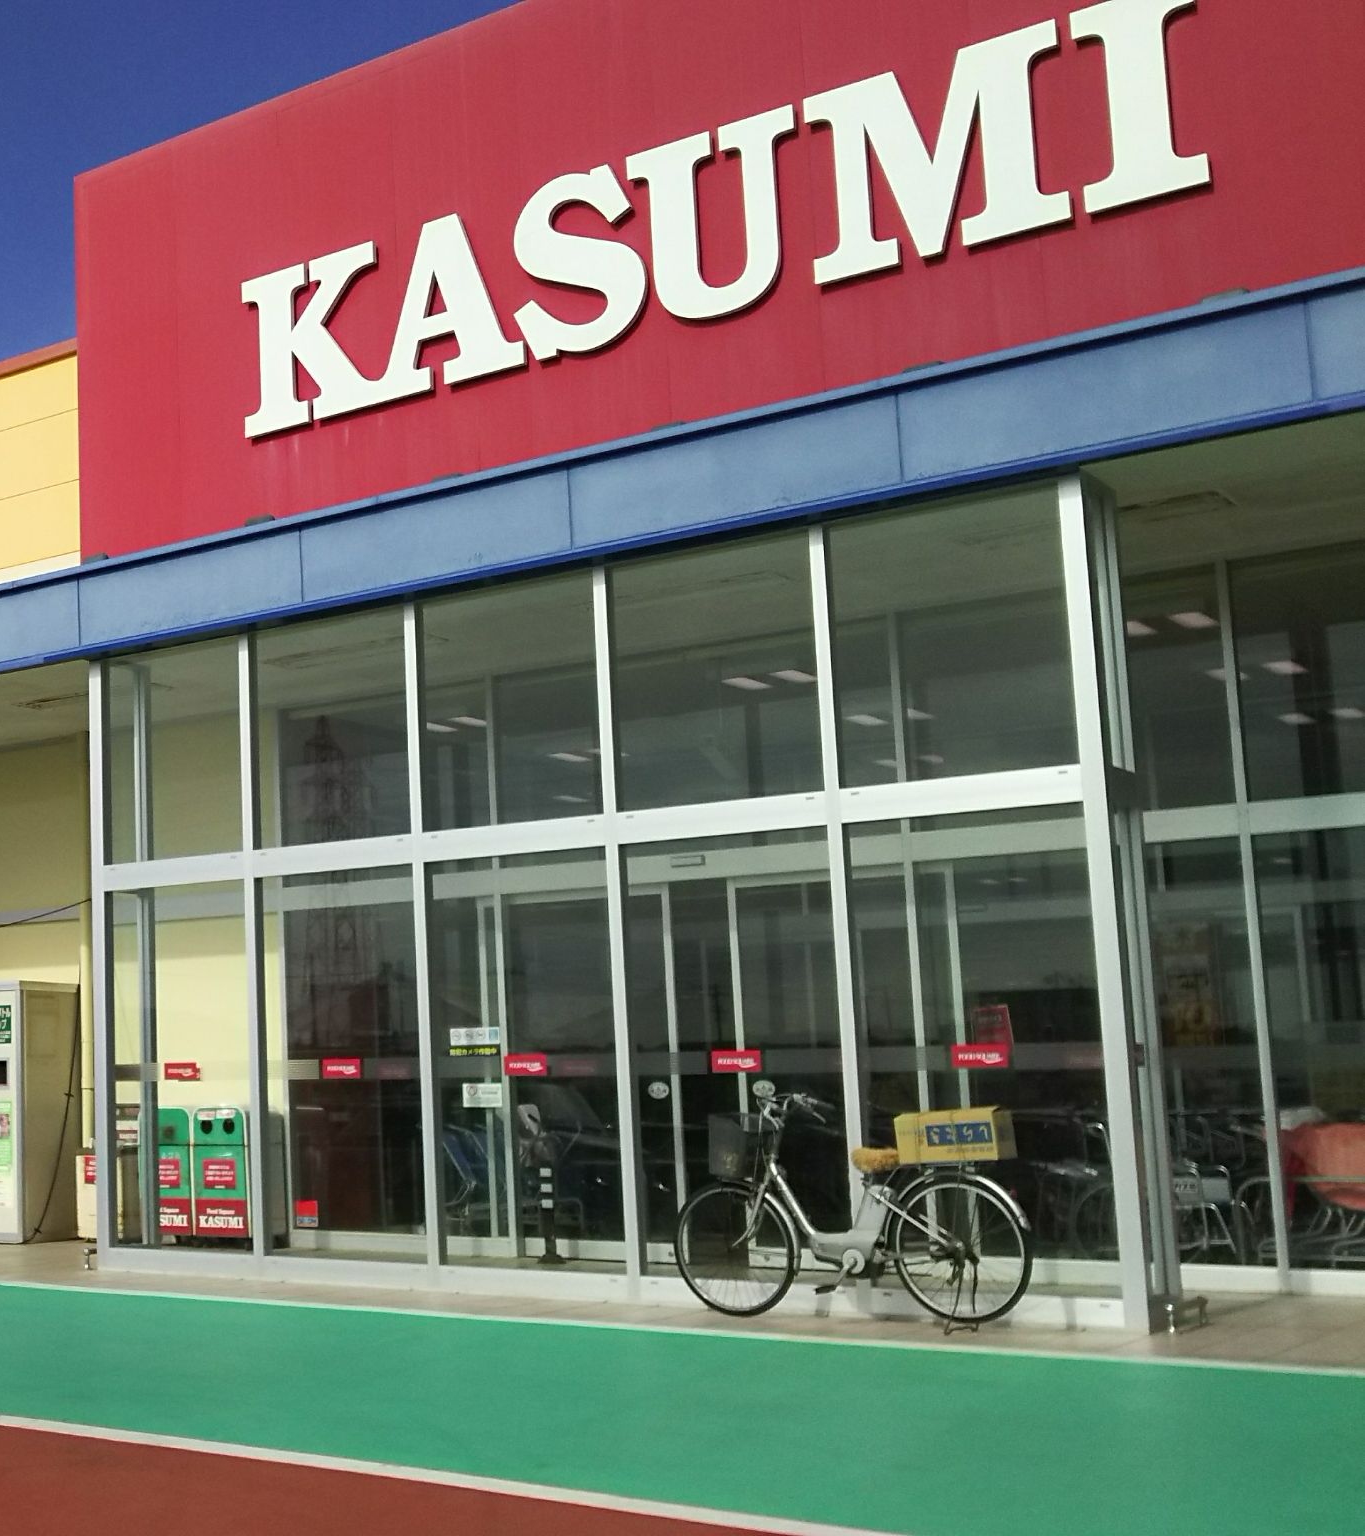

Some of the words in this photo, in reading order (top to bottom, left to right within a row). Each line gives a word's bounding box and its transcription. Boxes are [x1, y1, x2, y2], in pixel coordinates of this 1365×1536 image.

[241, 0, 1212, 440] KASUMI
[159, 1214, 188, 1227] SUMI
[198, 1216, 244, 1229] KASUMI
